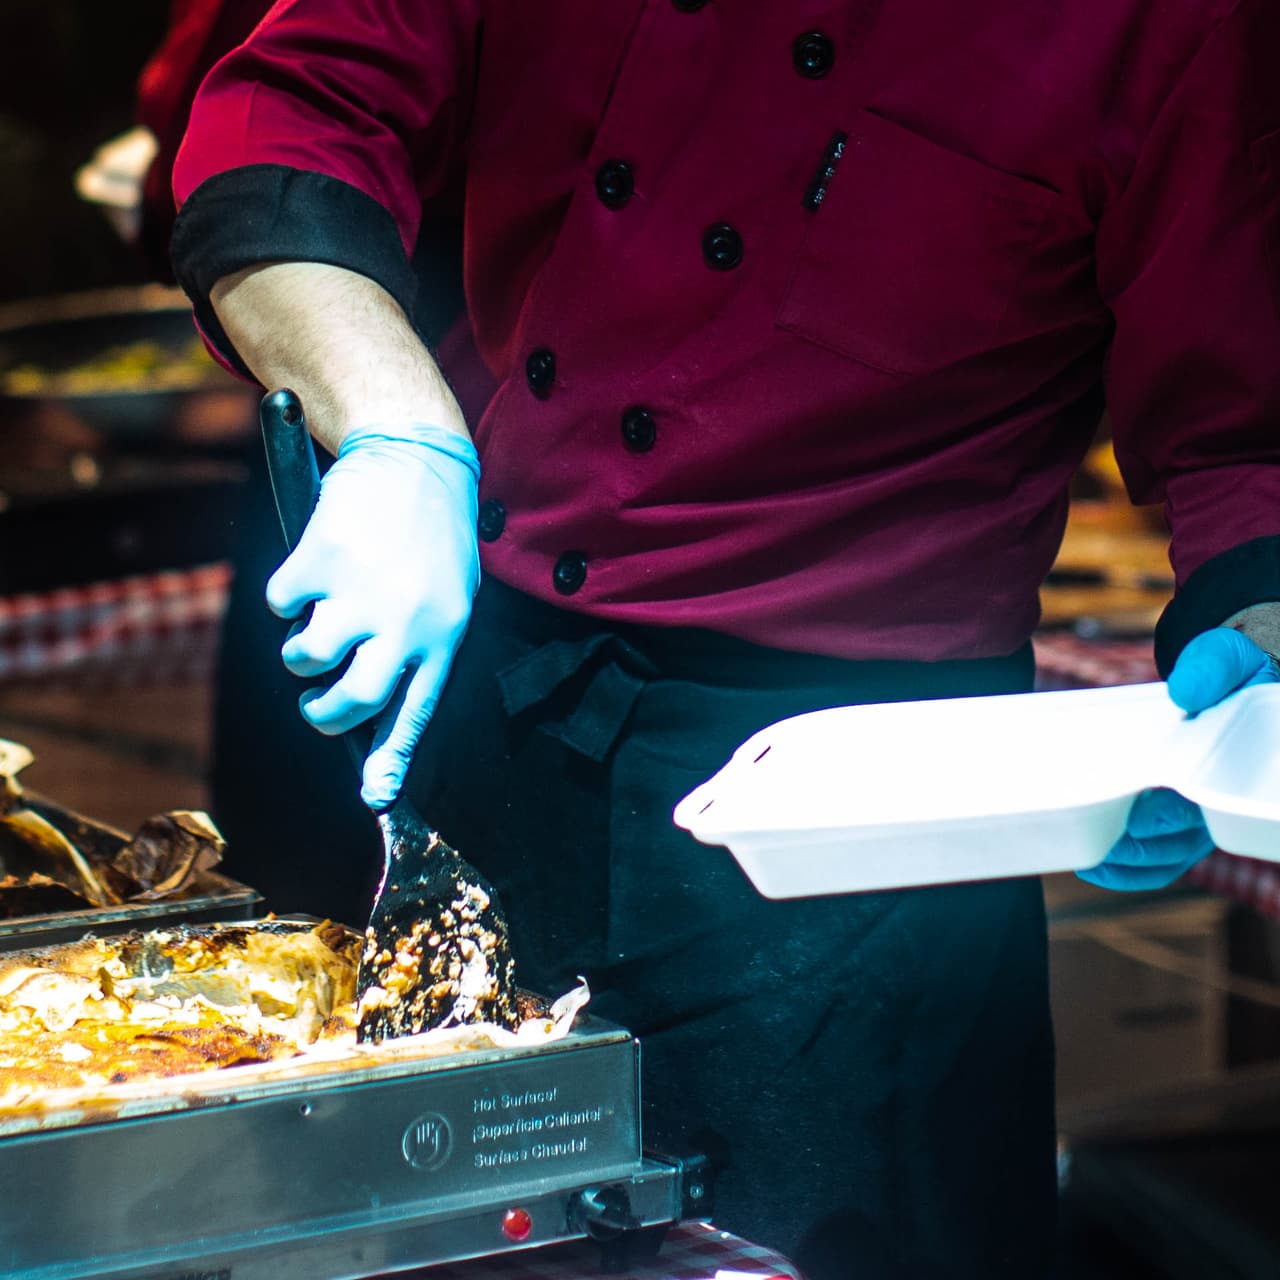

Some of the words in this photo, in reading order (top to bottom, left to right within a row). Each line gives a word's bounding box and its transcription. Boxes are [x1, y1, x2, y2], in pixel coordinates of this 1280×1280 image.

[473, 1097, 496, 1113] Hot
[500, 1087, 558, 1109] Surface!
[474, 1149, 528, 1168] Surface
[531, 1137, 587, 1159] Chaude!
